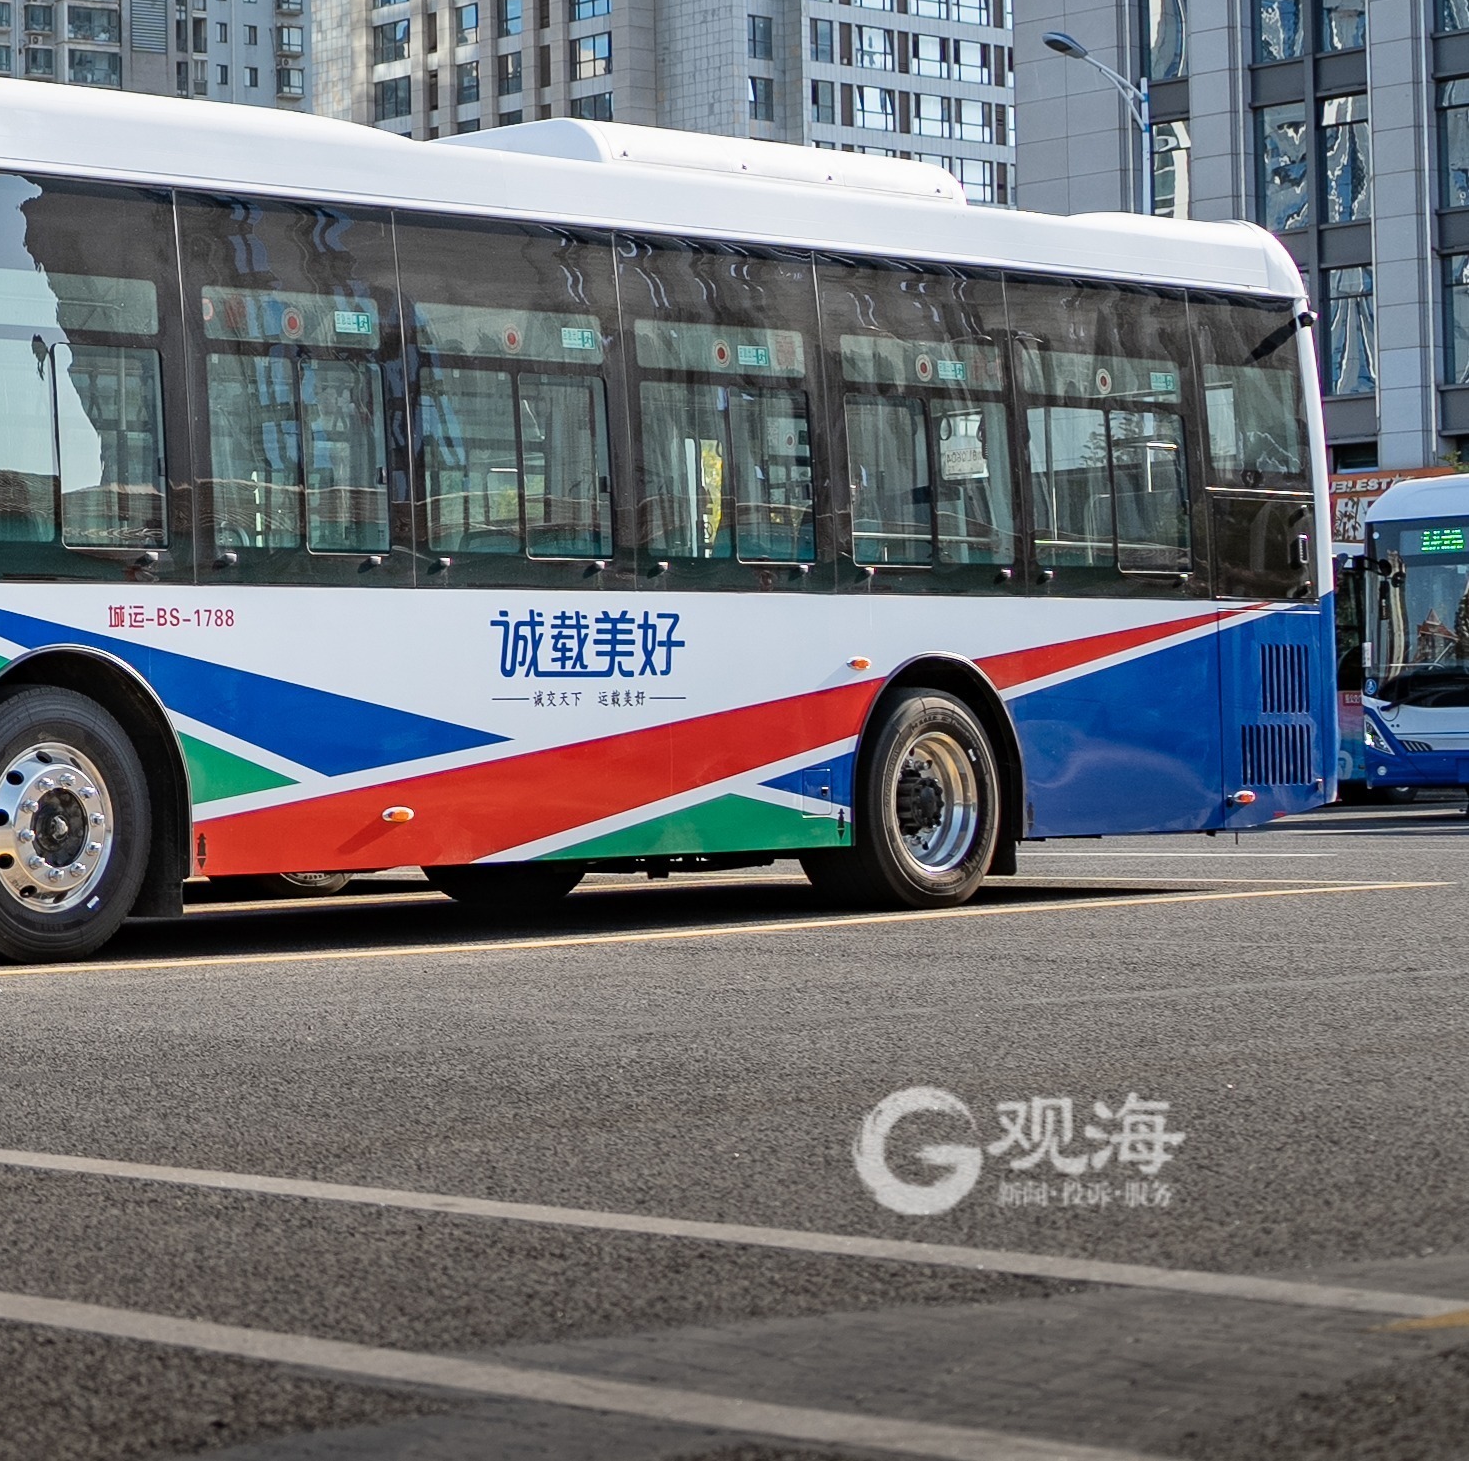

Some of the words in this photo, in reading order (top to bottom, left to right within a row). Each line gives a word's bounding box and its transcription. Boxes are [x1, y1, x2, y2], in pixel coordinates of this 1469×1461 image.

[108, 605, 235, 628] 城运-BS-1788
[489, 609, 686, 678] 诚载美好
[597, 689, 647, 707] 运载美好
